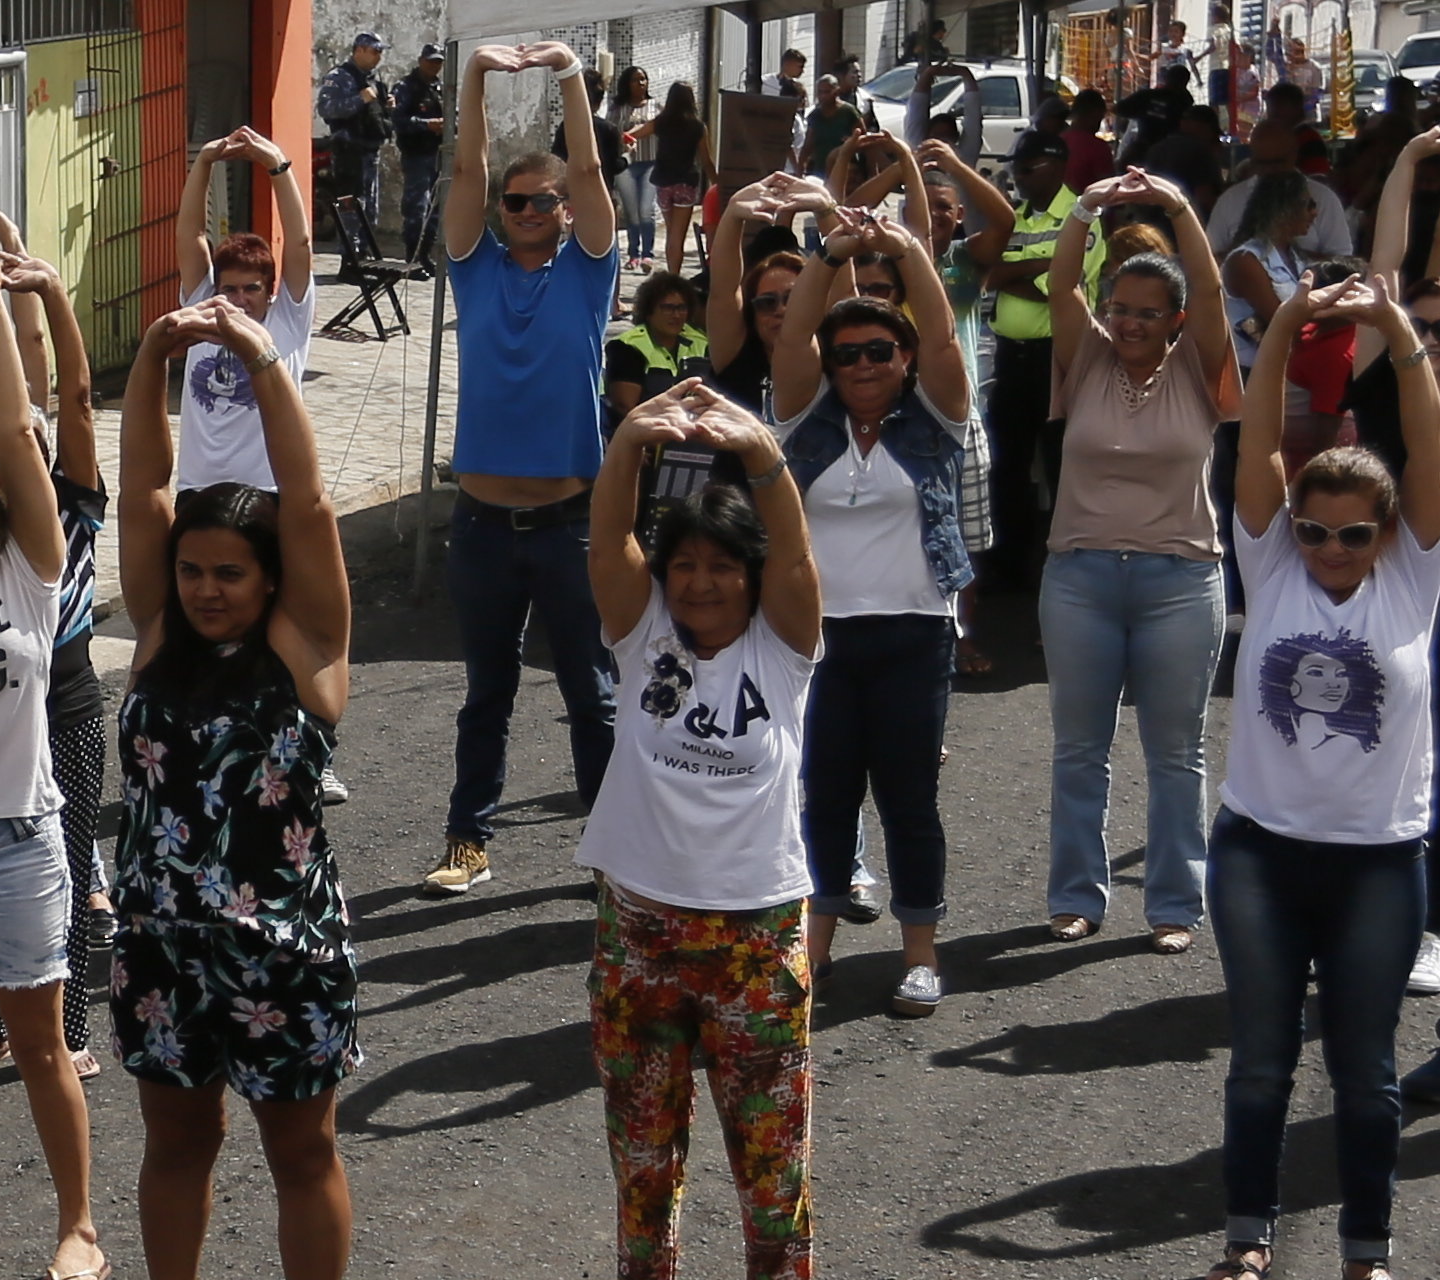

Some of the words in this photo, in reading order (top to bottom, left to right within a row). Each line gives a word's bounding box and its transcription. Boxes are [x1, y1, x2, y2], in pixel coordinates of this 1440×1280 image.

[682, 742, 734, 760] MILANO
[653, 753, 658, 762] I
[664, 755, 700, 774] WAS
